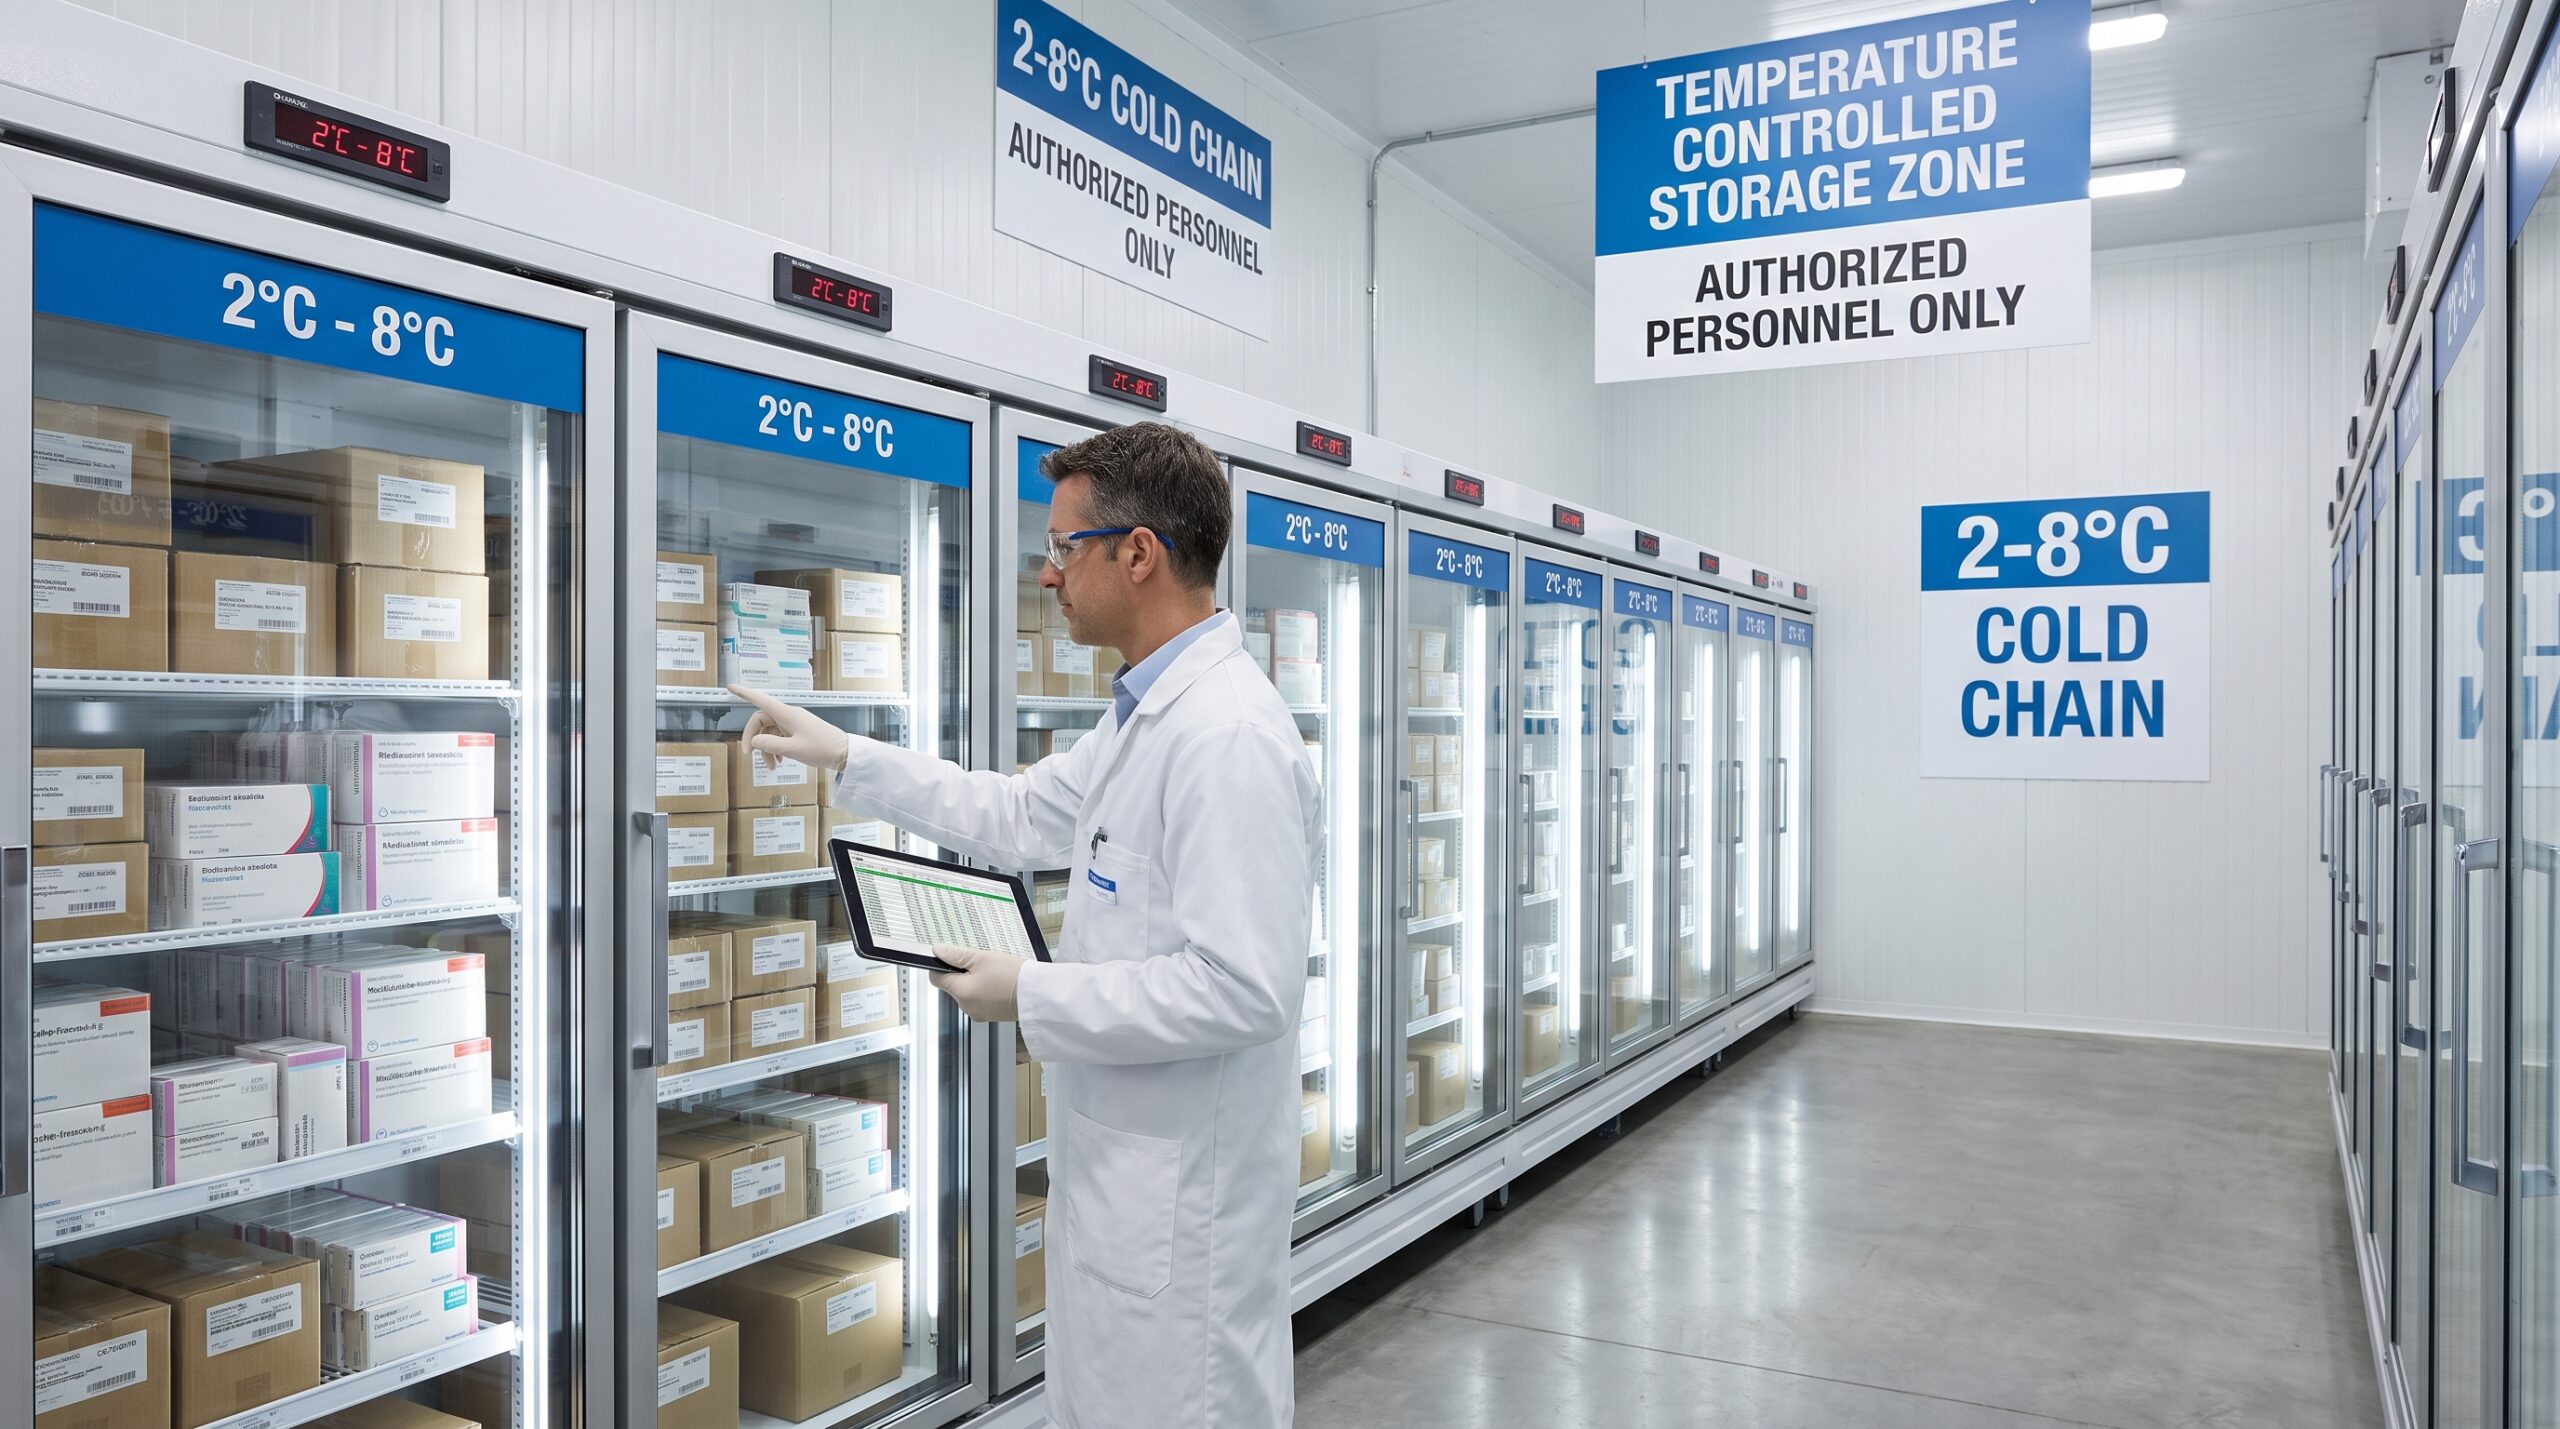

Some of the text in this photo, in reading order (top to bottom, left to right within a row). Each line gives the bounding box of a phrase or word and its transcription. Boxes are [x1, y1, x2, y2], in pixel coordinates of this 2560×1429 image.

[1656, 19, 2018, 119] TEMPERATURE
[1013, 18, 1262, 201] 2-8°C COLD CHAIN
[1673, 84, 1997, 172] CONTROLLED
[1008, 121, 1263, 276] AUTHORIZED PERSONNEL
[1649, 138, 2025, 231] STORAGE ZONE
[1125, 227, 1175, 280] ONLY
[1695, 237, 1967, 303] AUTHORIZED
[222, 272, 317, 340] 2°C
[371, 305, 455, 367] 8°C
[1646, 284, 2026, 358] PERSONNEL ONLY
[758, 394, 813, 442] 2°C
[843, 413, 894, 458] 8°C
[1286, 513, 1312, 545] 2°C
[1324, 521, 1348, 551] 8°C
[1436, 547, 1456, 574] 2°C
[1464, 554, 1483, 579] 8°C
[1957, 505, 2169, 579] 2-8°C
[1976, 604, 2148, 664] COLD
[1961, 679, 2164, 738] CHAIN
